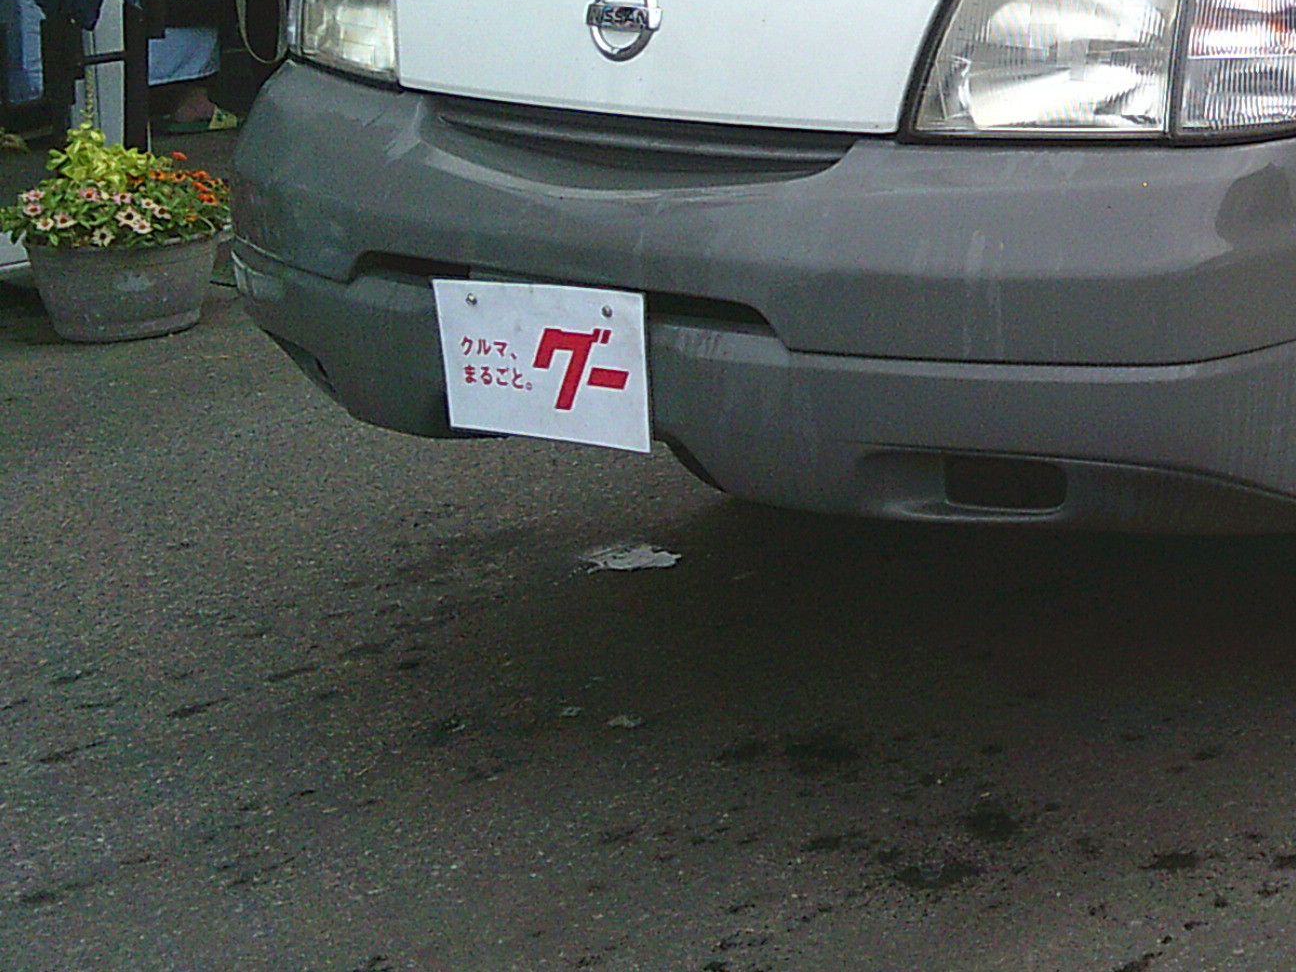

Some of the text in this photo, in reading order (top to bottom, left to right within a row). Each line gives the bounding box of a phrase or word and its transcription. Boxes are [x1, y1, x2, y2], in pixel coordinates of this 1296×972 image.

[591, 4, 648, 27] NISSAN
[460, 336, 518, 360] クルマ、
[463, 364, 533, 391] まるごと。
[532, 327, 630, 411] グー
